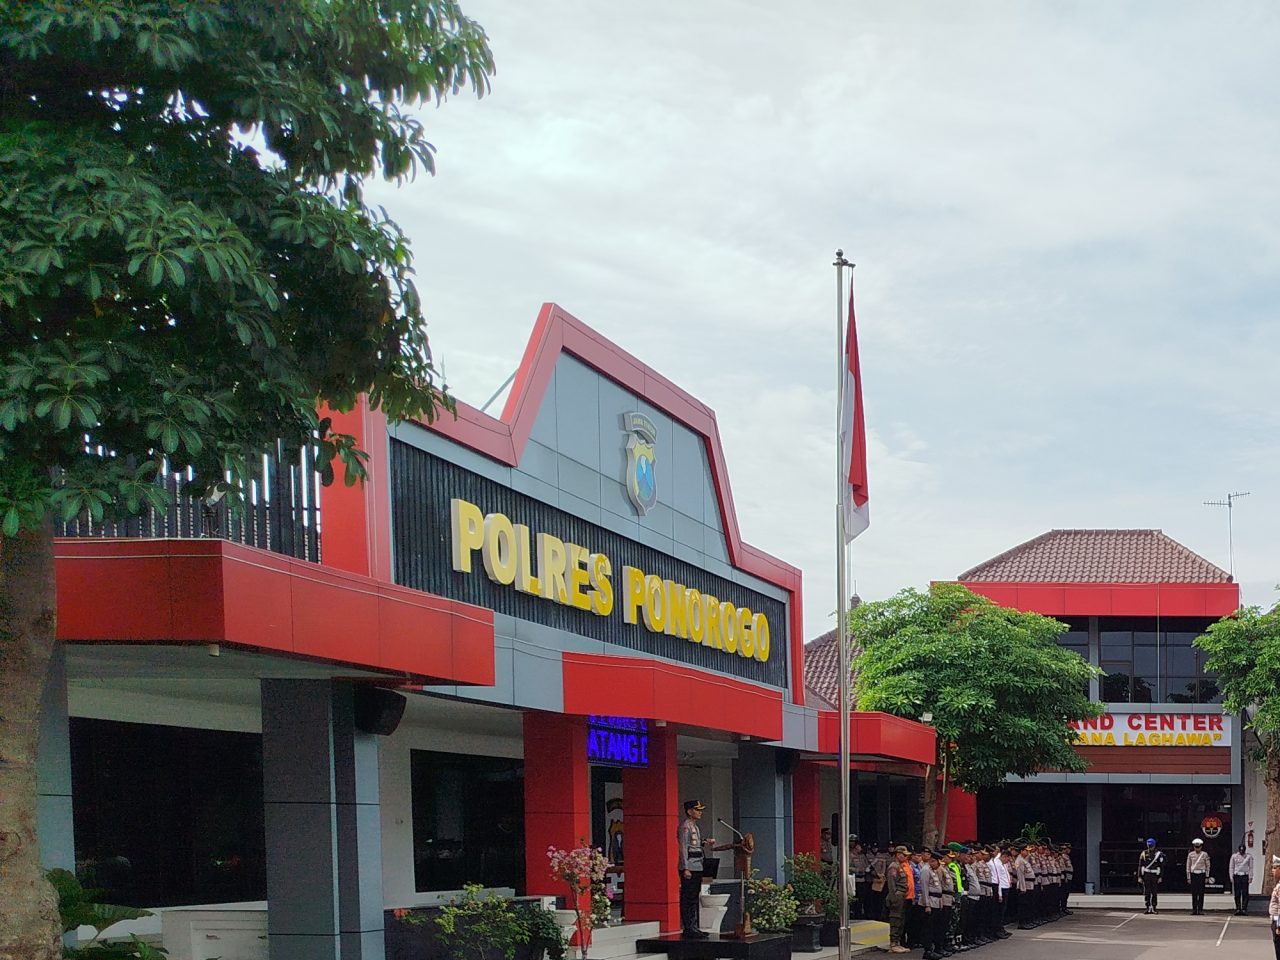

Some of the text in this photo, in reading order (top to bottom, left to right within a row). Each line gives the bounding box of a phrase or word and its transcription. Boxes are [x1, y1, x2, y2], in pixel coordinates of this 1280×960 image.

[451, 498, 770, 662] POLRES PONOROGO
[1127, 713, 1224, 731] CENTER
